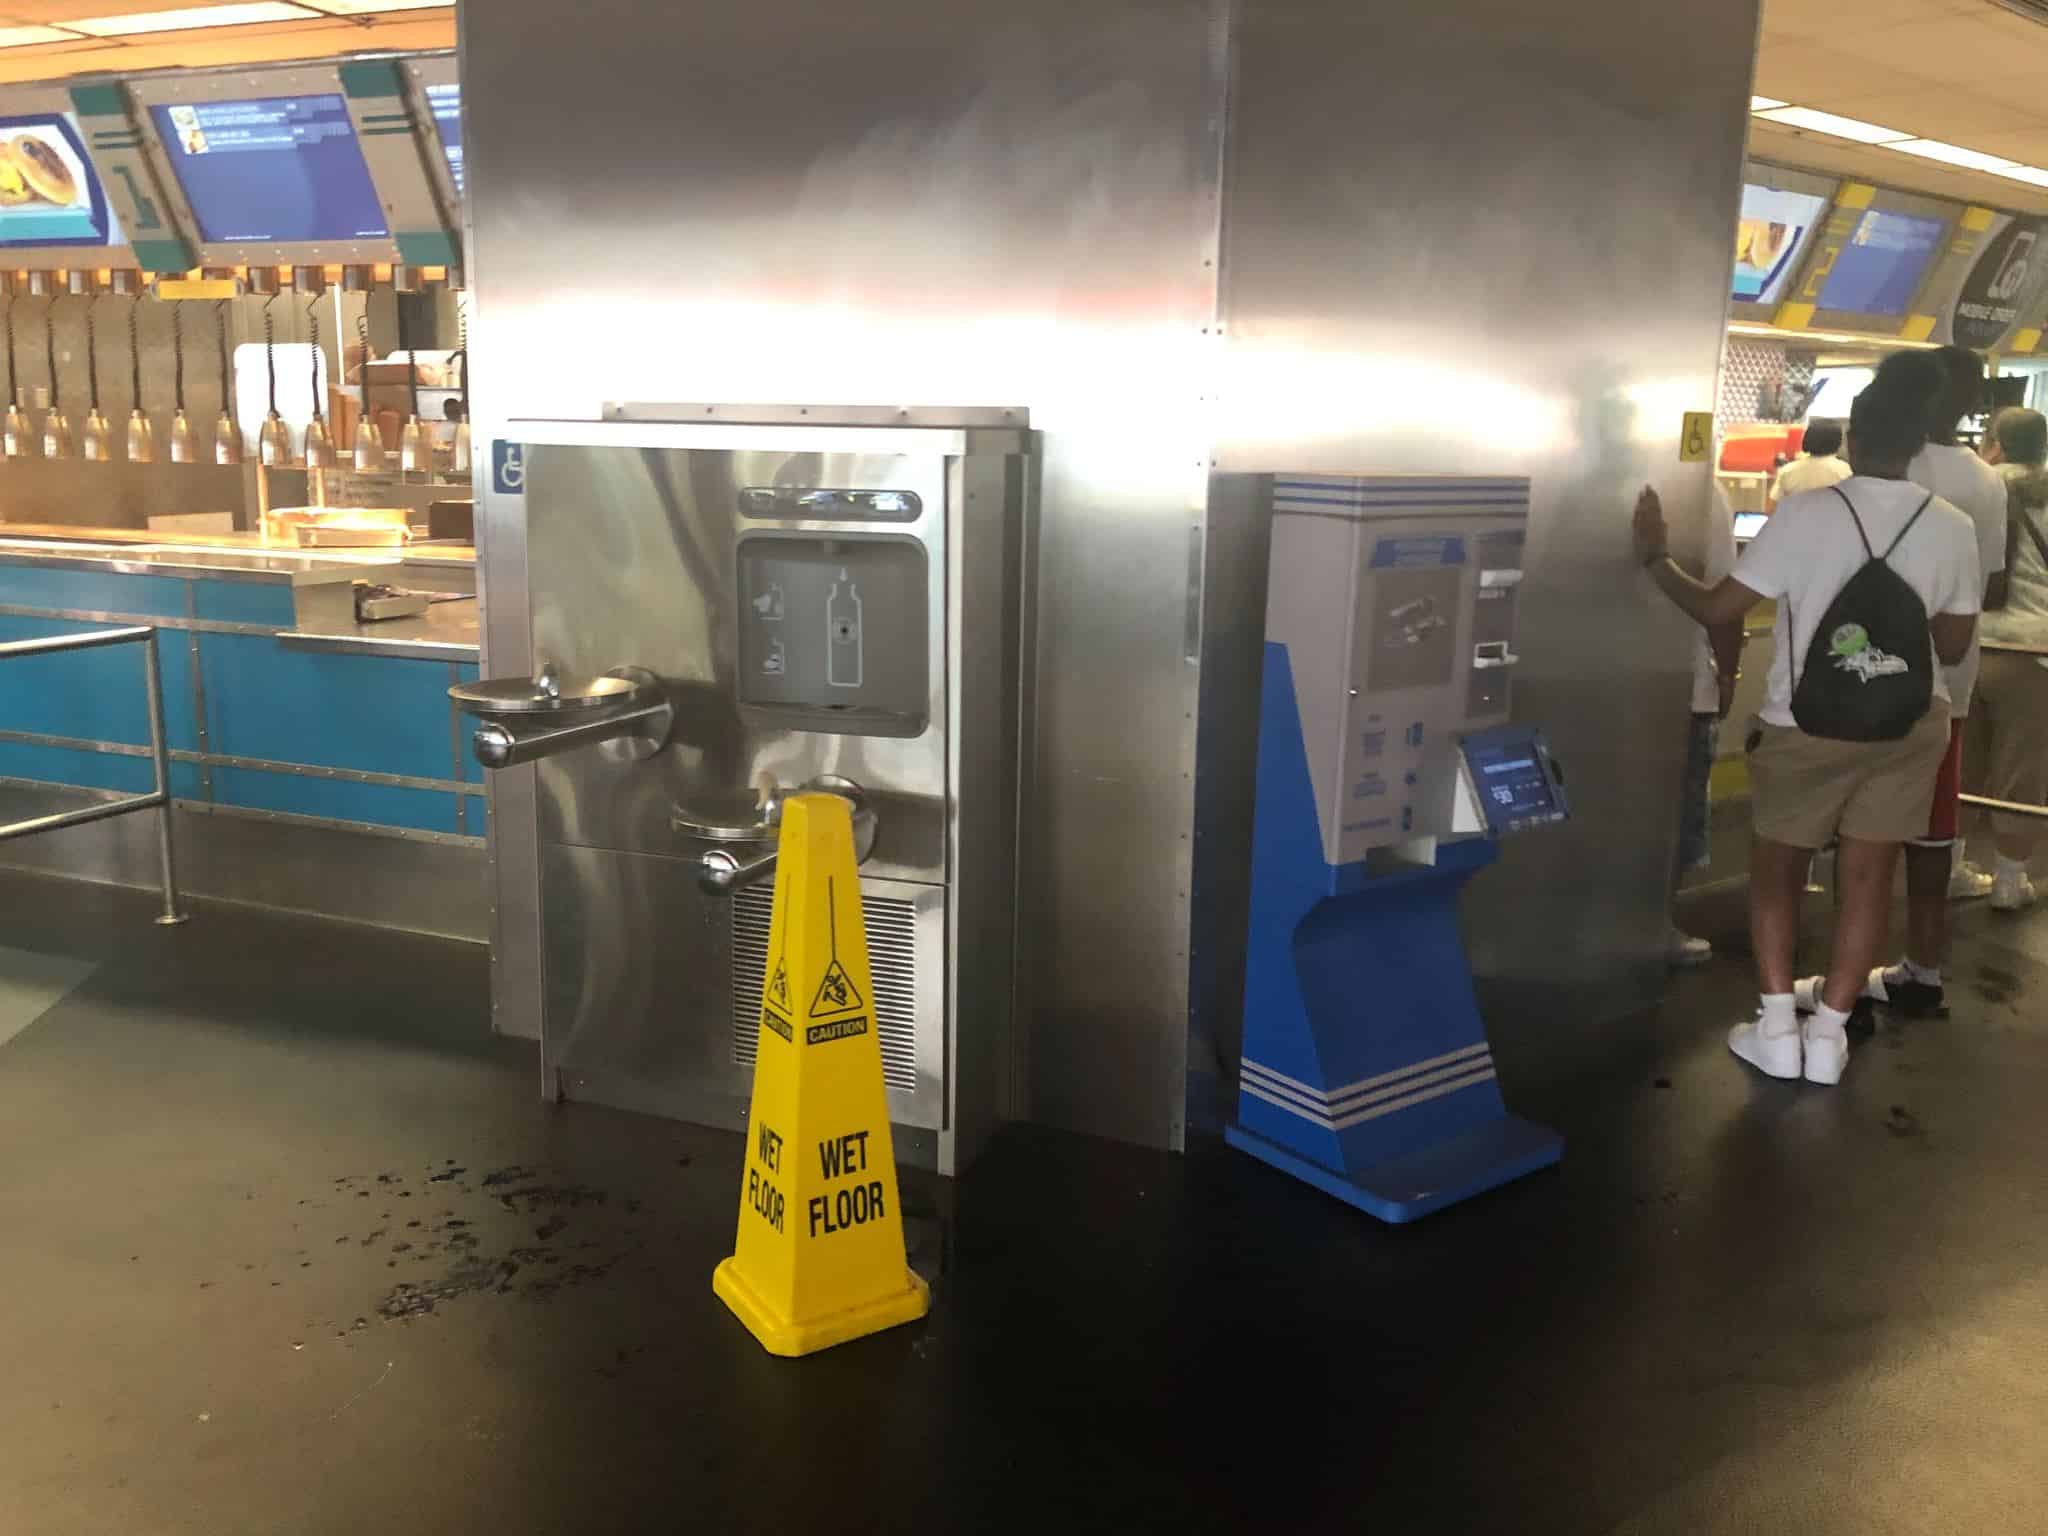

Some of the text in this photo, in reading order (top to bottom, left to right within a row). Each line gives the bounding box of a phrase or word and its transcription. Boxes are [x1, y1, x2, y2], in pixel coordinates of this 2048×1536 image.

[809, 1018, 866, 1042] CAUTION
[760, 1122, 783, 1175] WET
[819, 1131, 869, 1180] WET
[749, 1168, 784, 1234] FLOOR
[809, 1181, 884, 1238] FLOOR
